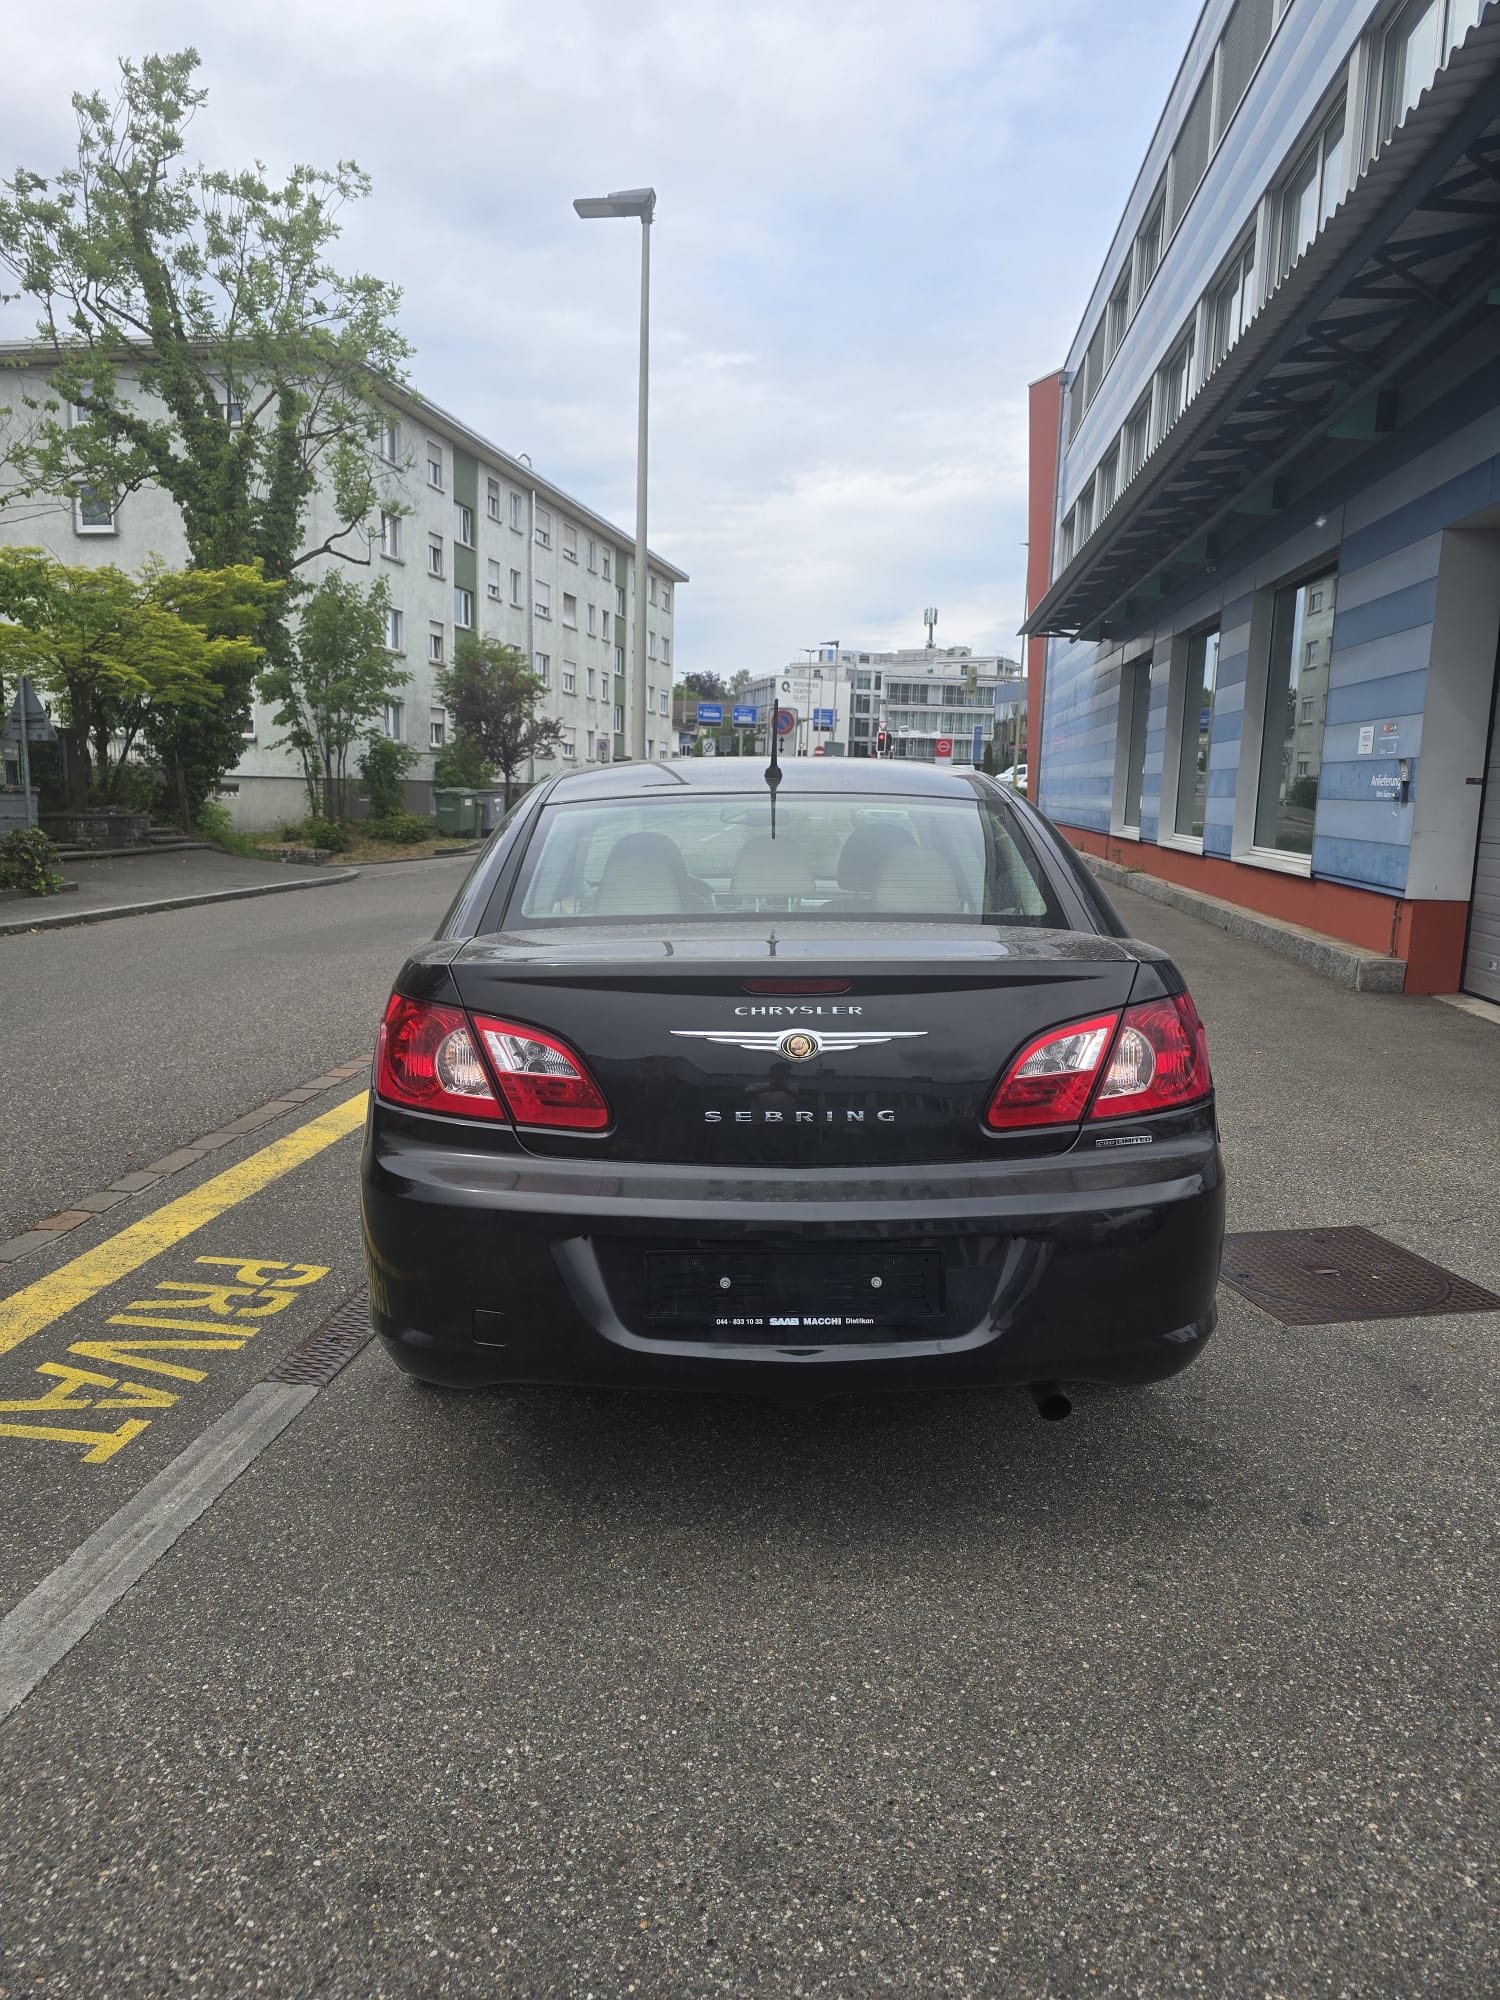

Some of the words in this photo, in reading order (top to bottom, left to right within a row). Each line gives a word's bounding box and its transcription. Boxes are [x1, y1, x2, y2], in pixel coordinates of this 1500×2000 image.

[1370, 774, 1401, 790] Anlieferung
[734, 1005, 864, 1017] CHRYSLER
[704, 1109, 896, 1123] SEBRING
[1117, 1136, 1151, 1145] LIMITED
[0, 1255, 334, 1464] PRIVAT
